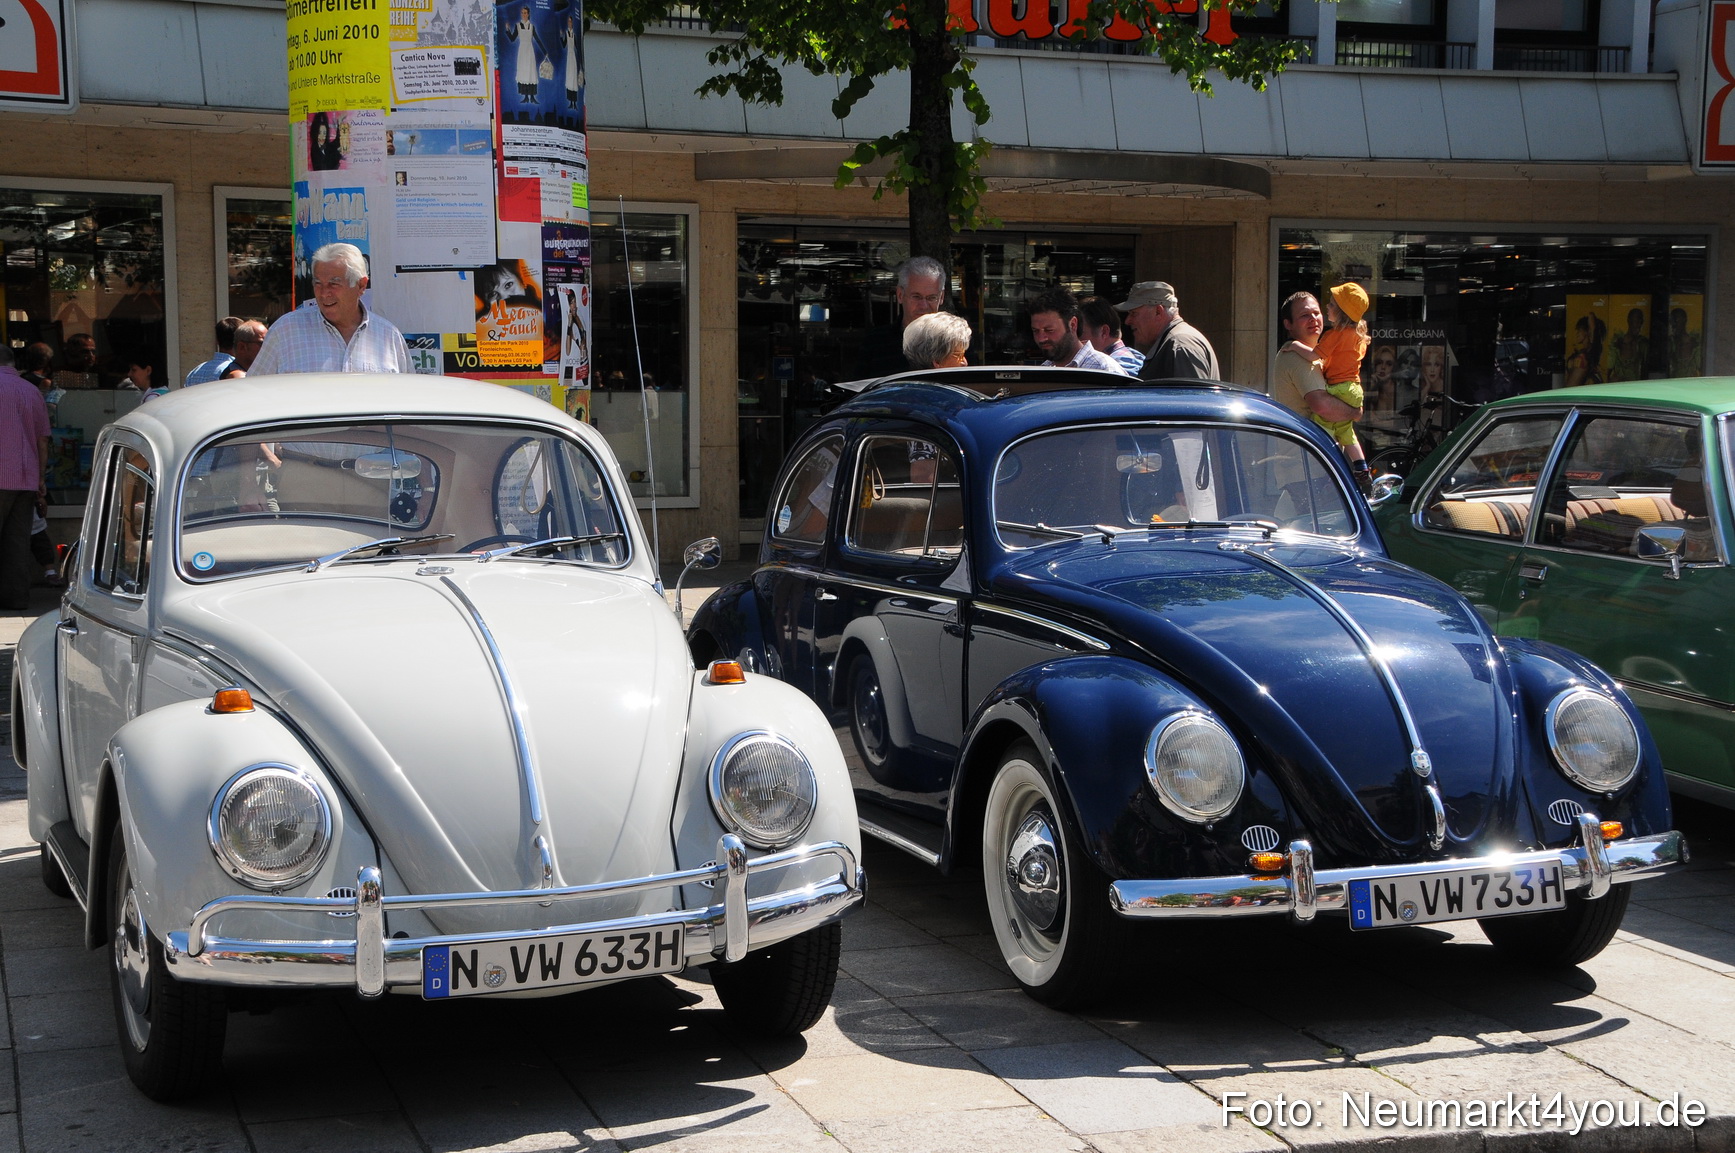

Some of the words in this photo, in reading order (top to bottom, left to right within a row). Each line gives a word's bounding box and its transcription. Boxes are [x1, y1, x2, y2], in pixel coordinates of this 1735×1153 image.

[389, 10, 417, 26] REIHE
[303, 28, 311, 45] 6.
[313, 25, 339, 43] Juni
[342, 24, 380, 40] 2010
[295, 51, 316, 69] 10.00
[320, 49, 343, 65] Uhr
[400, 53, 426, 62] Cantica
[427, 52, 446, 61] Nova
[320, 71, 381, 86] Marktstraße
[1371, 328, 1399, 339] DOLCE
[1403, 328, 1446, 339] GABBANA
[1373, 883, 1398, 921] N
[1419, 876, 1464, 916] VW
[1471, 866, 1562, 911] 733H
[1357, 909, 1366, 920] D
[451, 949, 478, 990] N
[509, 941, 564, 984] VW
[574, 929, 680, 977] 633H
[432, 977, 442, 990] D
